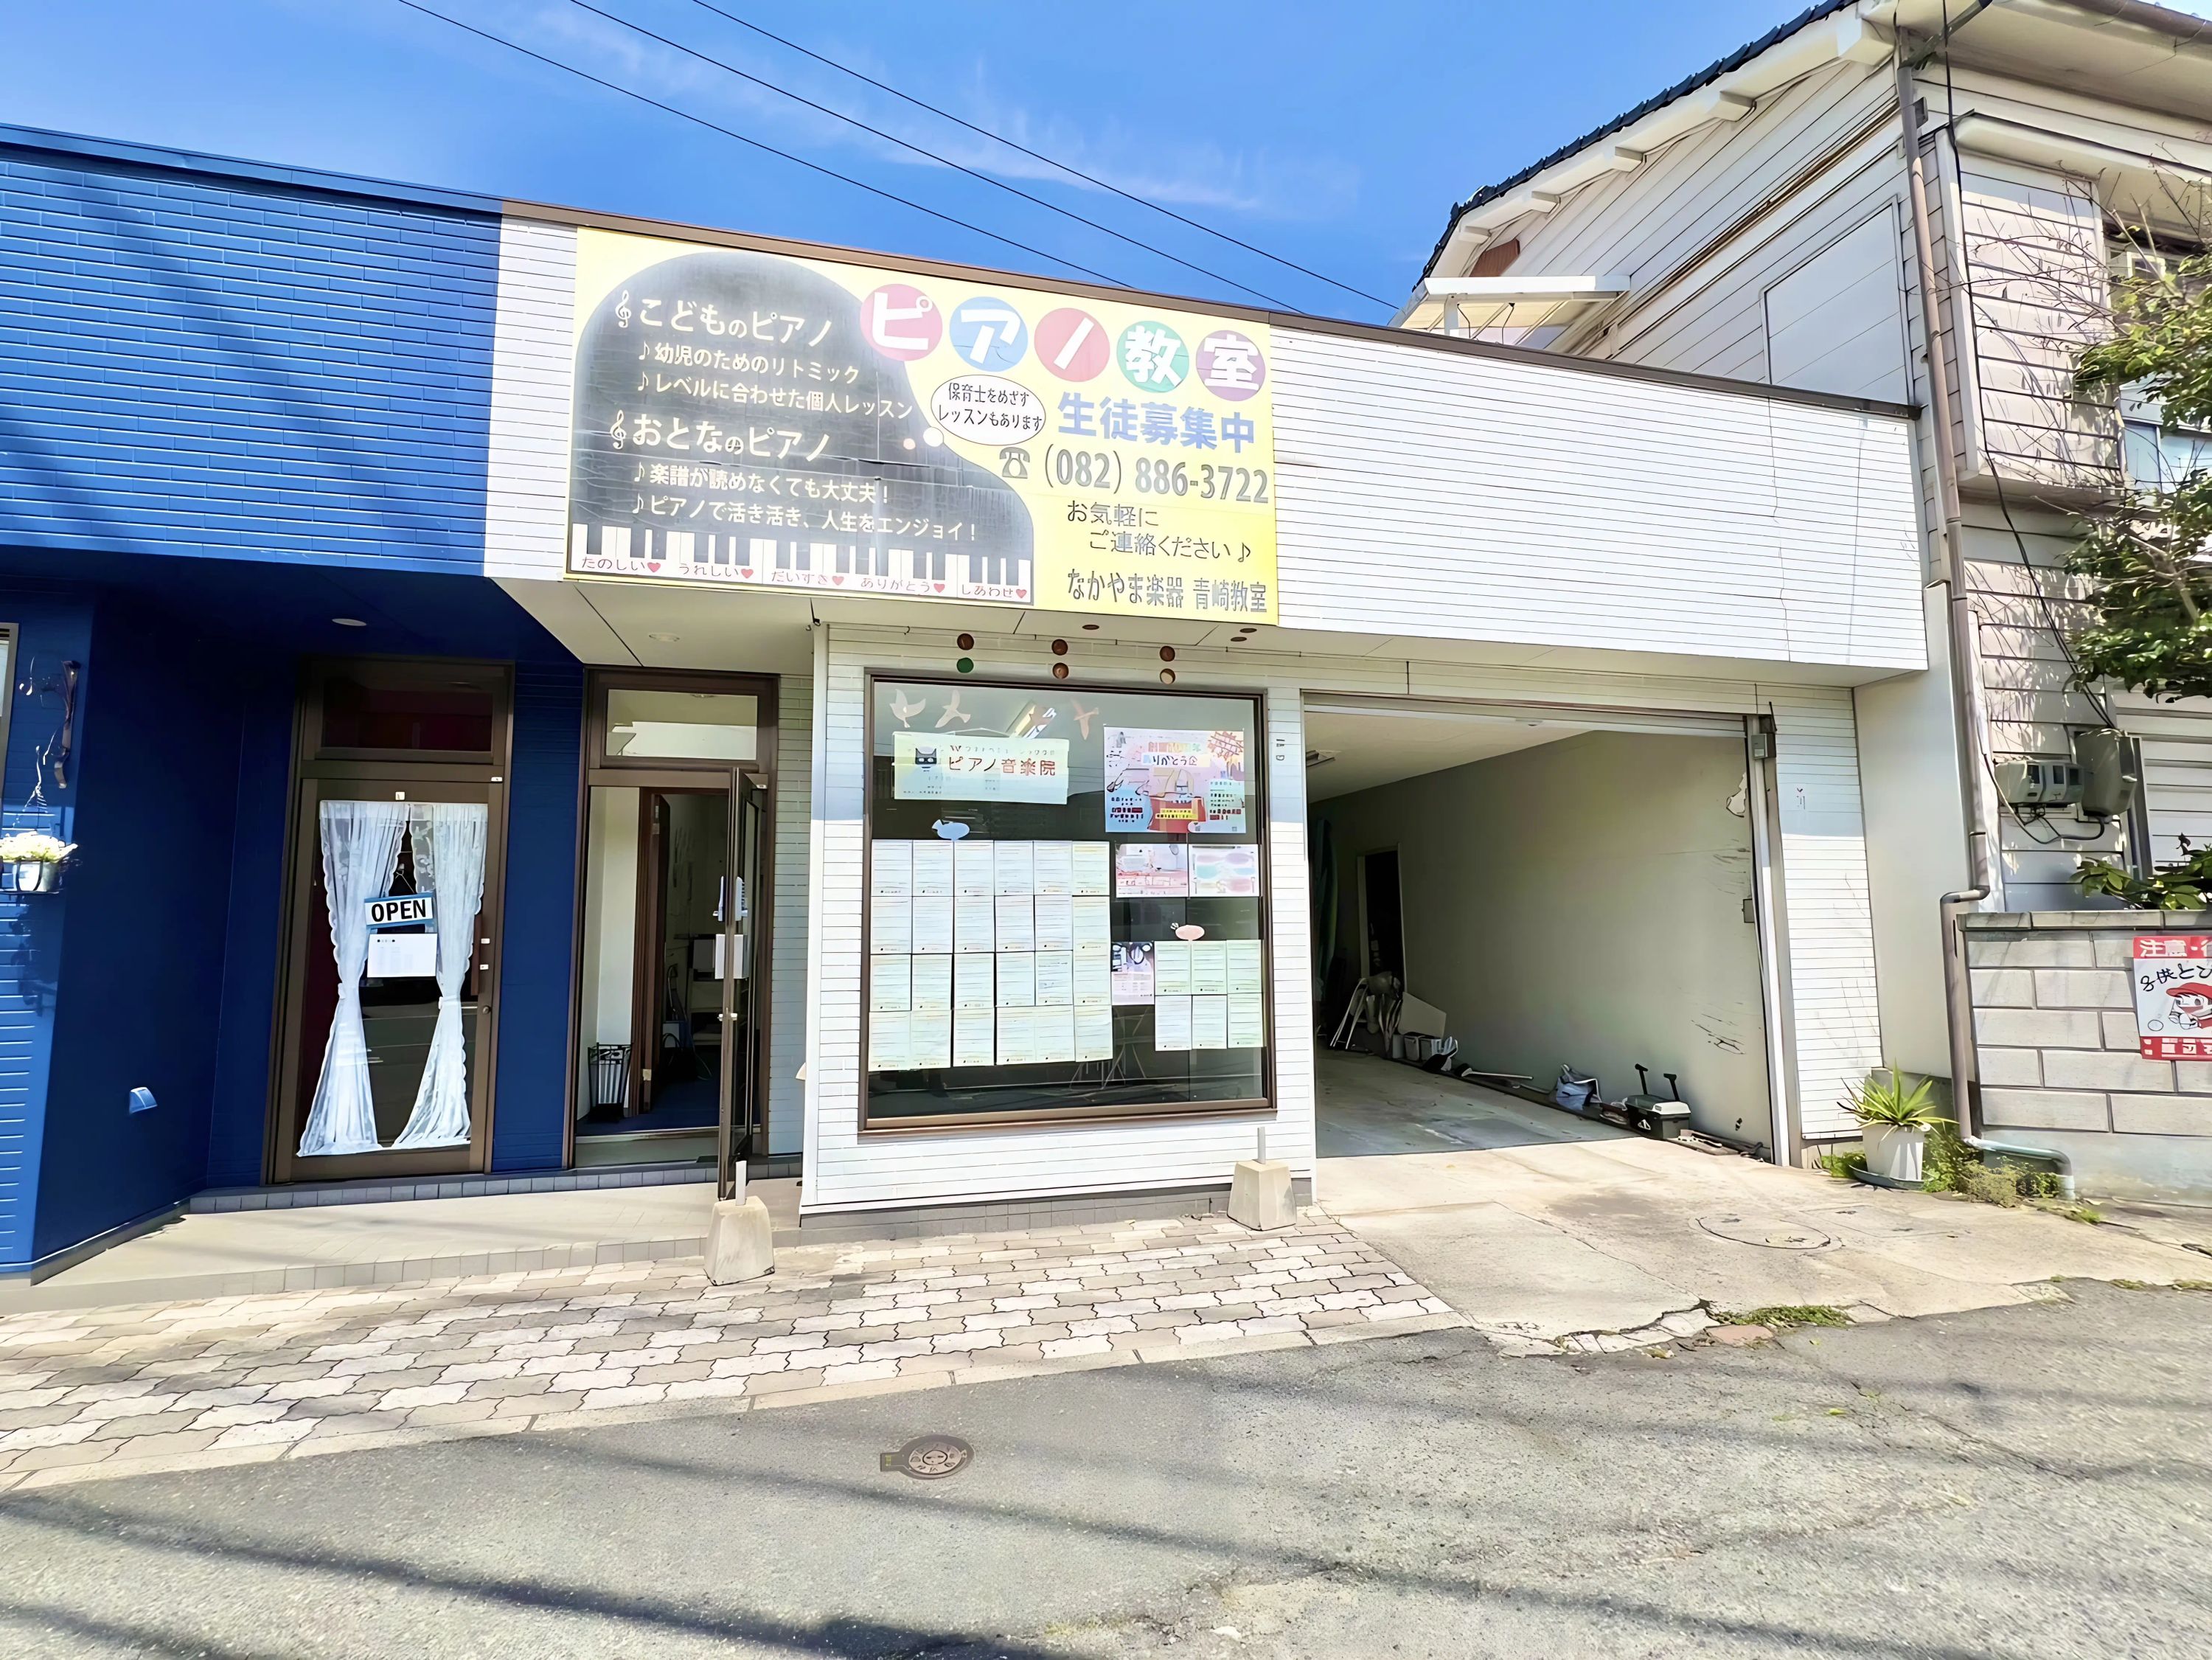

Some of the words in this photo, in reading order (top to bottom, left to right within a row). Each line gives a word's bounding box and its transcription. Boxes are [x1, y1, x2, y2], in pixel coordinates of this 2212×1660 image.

[639, 298, 832, 347] こどものピアノ
[872, 292, 1260, 392] ピアノ教室
[654, 341, 859, 384] 幼児のためのリトミック
[655, 372, 914, 419] レベルに合わせた個人レッスン
[947, 382, 1029, 408] 保育士をめざす
[937, 403, 1043, 431] レッスンもあります
[1057, 392, 1254, 454] 生徒募集中
[633, 413, 830, 462] おとなのピアノ
[1045, 444, 1121, 494] (082)
[1135, 456, 1268, 504] 886-3722
[1067, 500, 1159, 528] お気軽に
[581, 556, 645, 572] たのしい
[678, 562, 739, 578] うれしい
[771, 570, 829, 586] だいすき
[860, 577, 931, 593] ありがとう
[961, 583, 1013, 598] しあわせ
[1068, 568, 1184, 609] なかやま楽器
[949, 757, 1056, 776] ピアノ音楽院
[371, 899, 426, 922] OPEN
